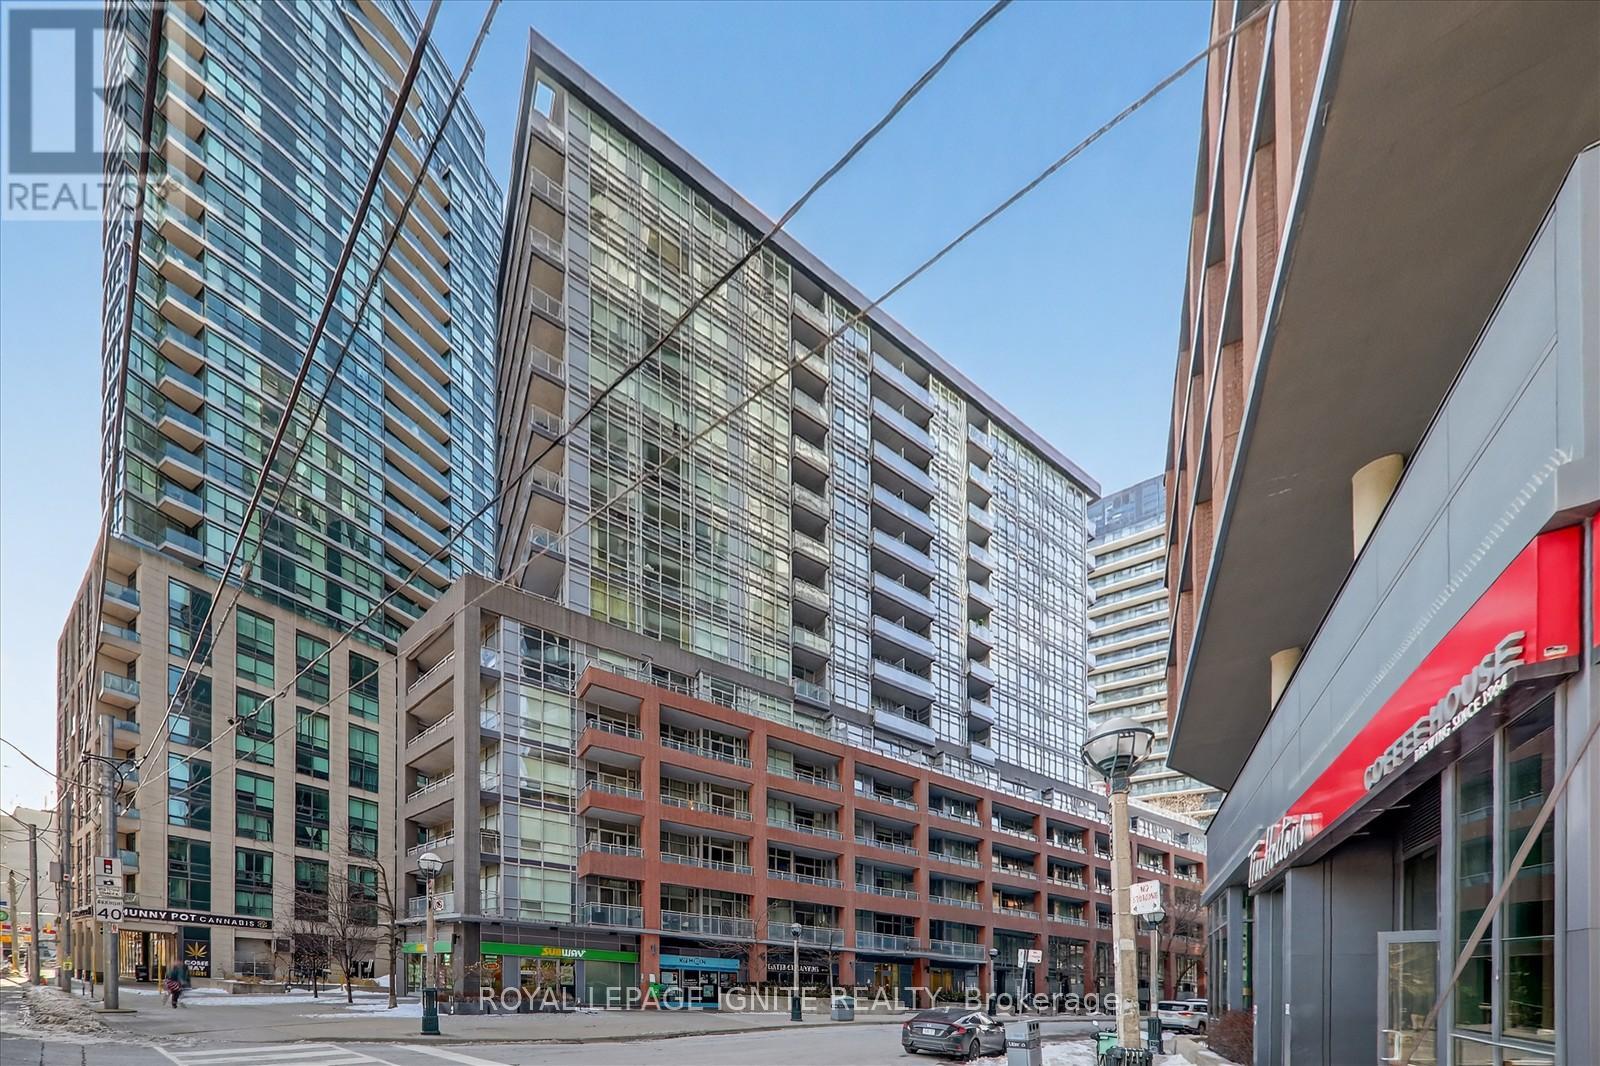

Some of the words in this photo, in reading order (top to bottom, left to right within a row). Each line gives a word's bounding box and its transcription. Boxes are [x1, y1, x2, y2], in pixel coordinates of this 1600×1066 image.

[1414, 721, 1452, 763] BREWING
[1452, 696, 1482, 732] SINCE
[97, 908, 122, 920] 40
[171, 912, 197, 922] POT
[199, 916, 255, 928] CANNABIS
[542, 947, 587, 958] SUBWAY
